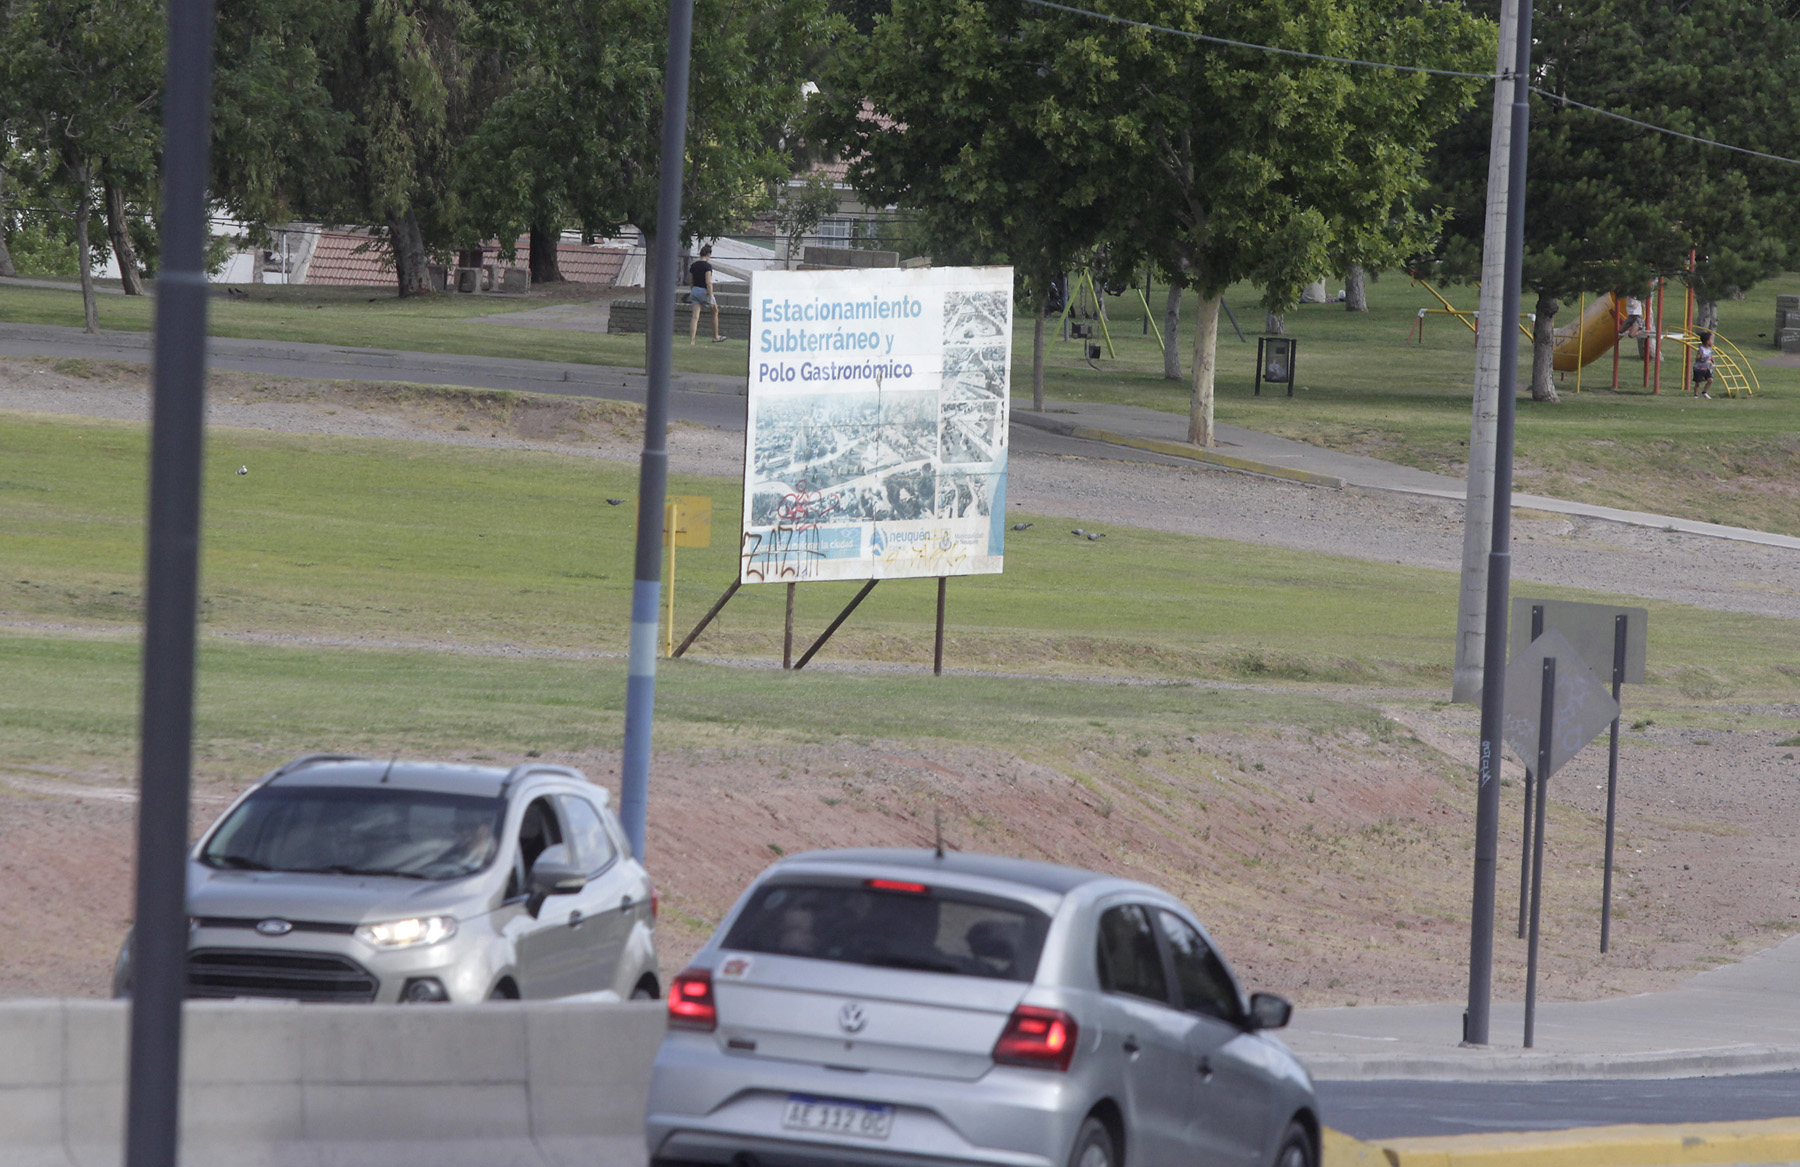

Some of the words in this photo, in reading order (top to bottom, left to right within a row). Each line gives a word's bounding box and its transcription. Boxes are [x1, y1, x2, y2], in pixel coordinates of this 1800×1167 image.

[761, 295, 922, 322] Estacionamiento
[760, 326, 880, 353] Subterráneo
[885, 333, 894, 354] y
[759, 362, 796, 383] Polo
[800, 359, 913, 382] Gastronómico
[821, 539, 829, 549] la
[829, 538, 854, 549] ciudad
[889, 527, 931, 544] neuquén
